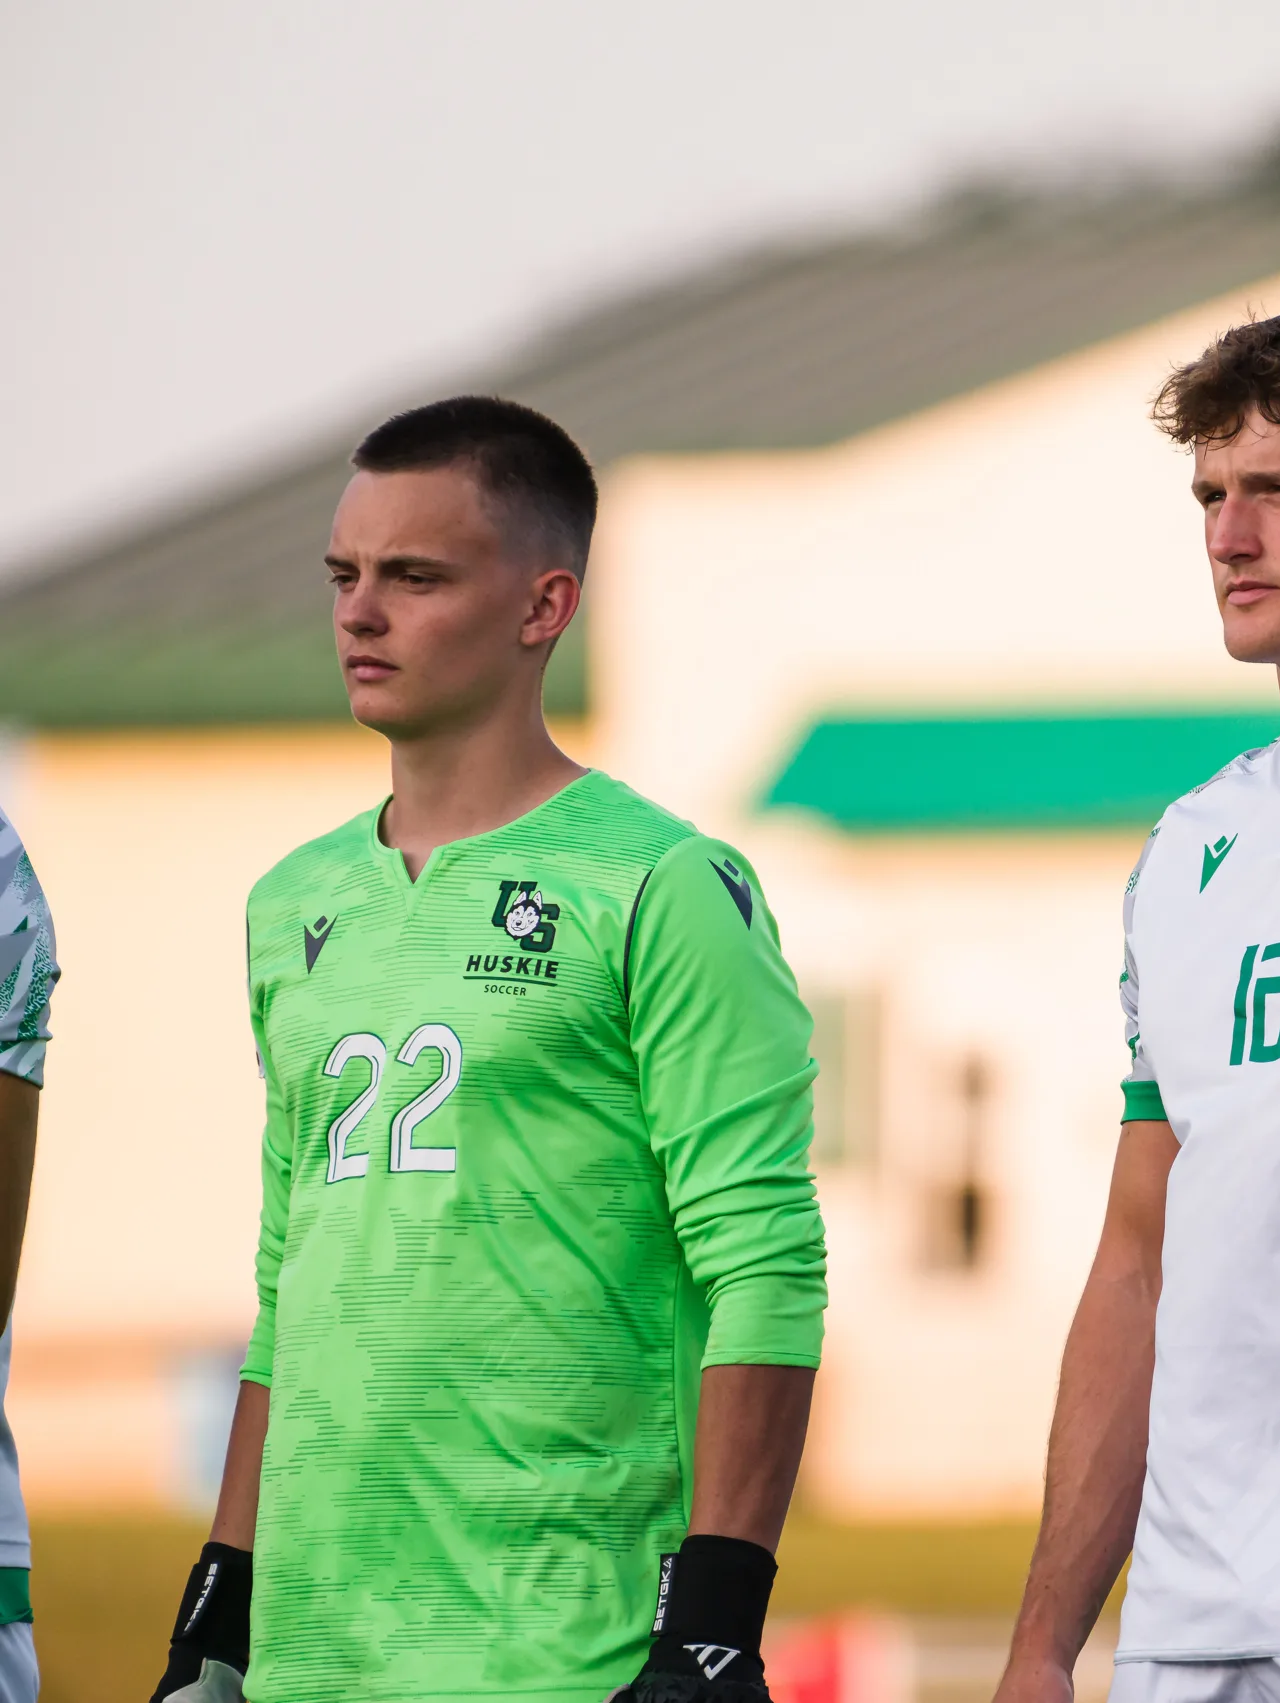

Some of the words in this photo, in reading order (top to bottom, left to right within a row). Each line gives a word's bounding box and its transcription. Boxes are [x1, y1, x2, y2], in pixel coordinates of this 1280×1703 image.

[466, 955, 559, 979] HUSKIE
[484, 984, 527, 996] SOCCER
[322, 1022, 463, 1185] 22
[653, 1570, 671, 1632] SETGK
